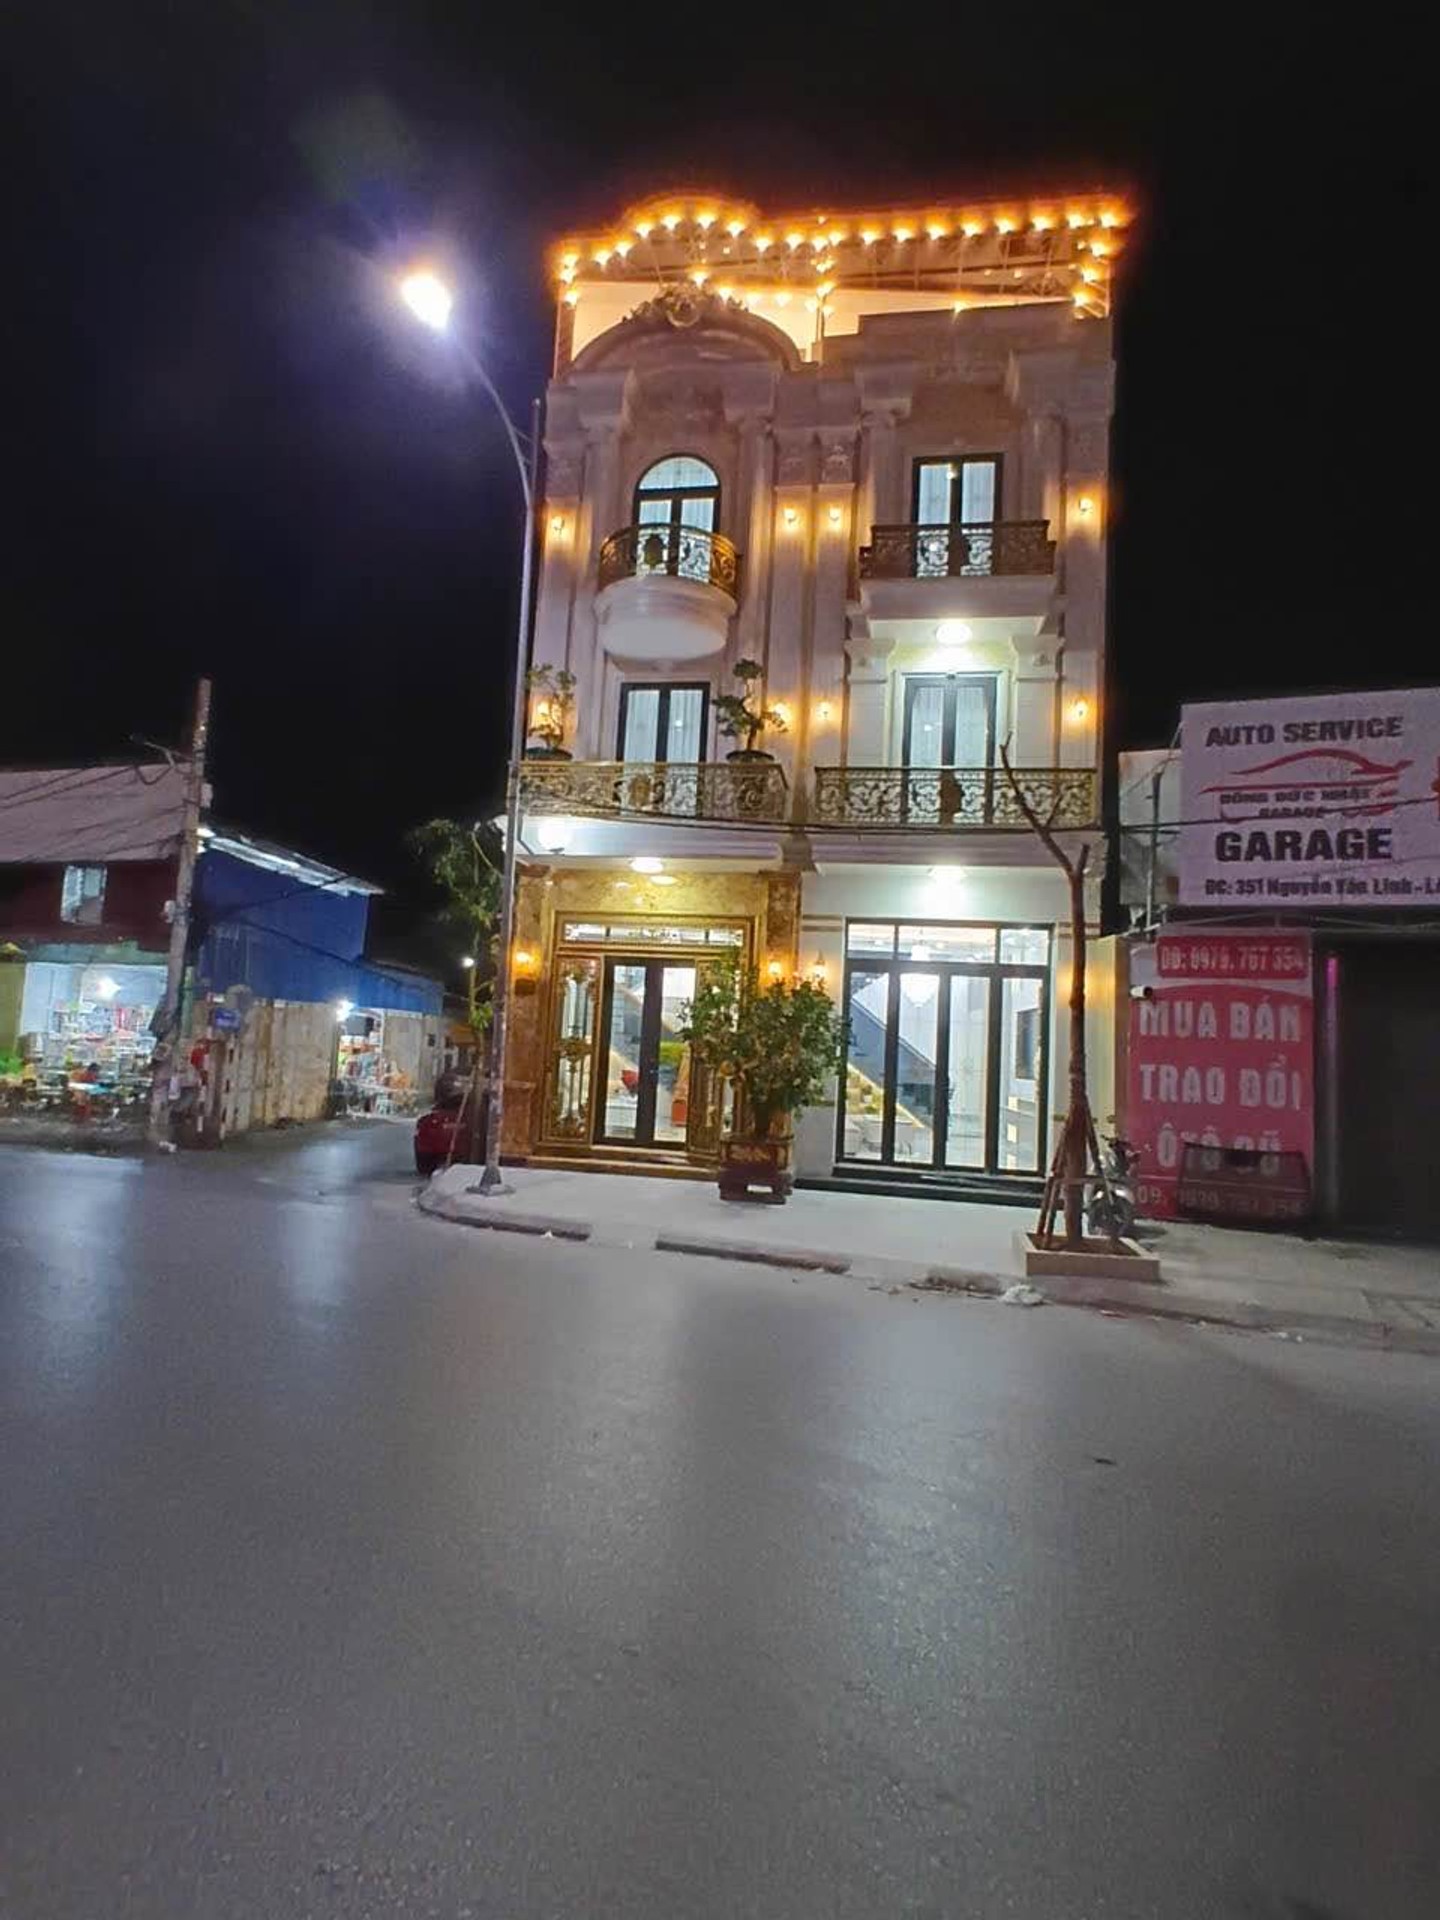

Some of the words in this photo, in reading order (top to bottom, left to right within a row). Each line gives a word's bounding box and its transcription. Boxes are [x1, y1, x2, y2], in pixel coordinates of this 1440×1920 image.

[1206, 724, 1275, 747] AUTO
[1283, 716, 1404, 744] SERVICE
[1215, 828, 1392, 862] GARAGE
[1235, 878, 1264, 895] 351
[1268, 876, 1332, 898] Nguyễn
[1373, 877, 1411, 895] Linh
[1139, 1000, 1217, 1038] MUA
[1229, 995, 1302, 1043] BÁN
[1140, 1064, 1226, 1105] TRAO
[1239, 1054, 1302, 1110] ĐỔI
